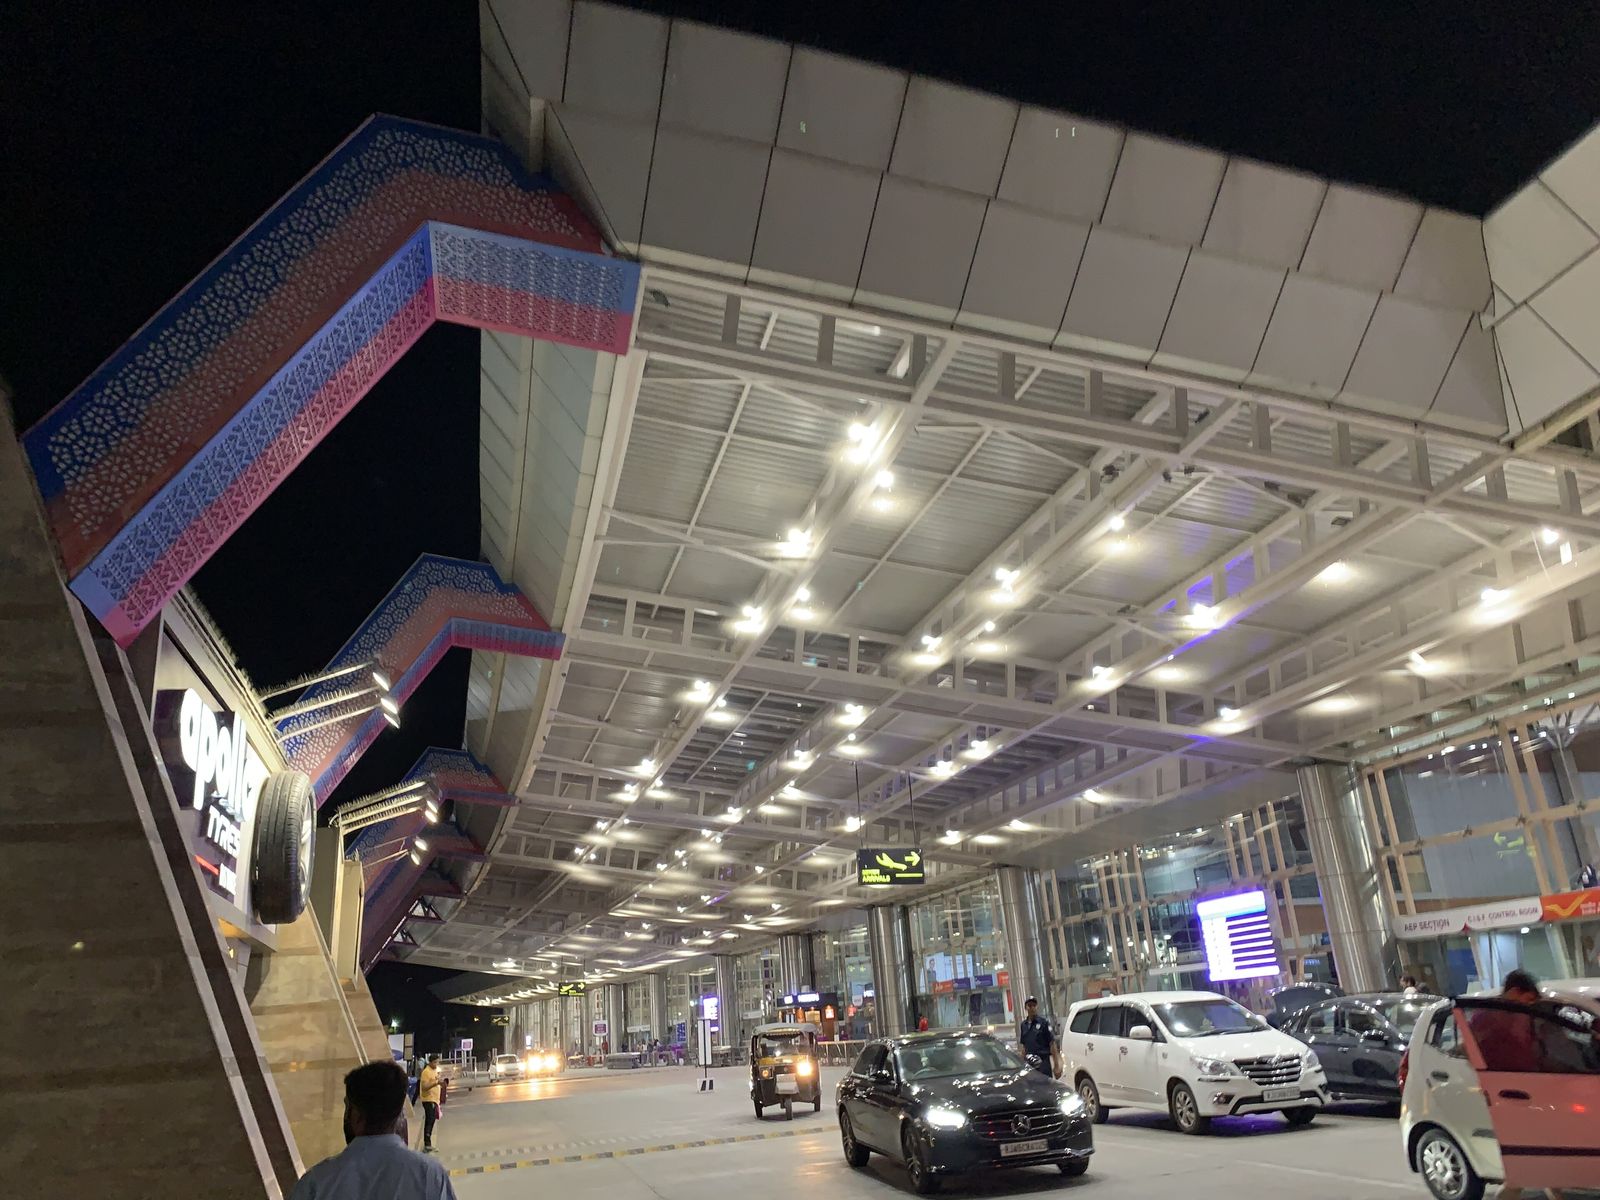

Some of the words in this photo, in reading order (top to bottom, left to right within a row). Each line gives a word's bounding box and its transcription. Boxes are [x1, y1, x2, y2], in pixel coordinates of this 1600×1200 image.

[207, 804, 241, 859] TYRES
[1488, 909, 1518, 920] CONTROL
[1419, 918, 1451, 931] SECTION
